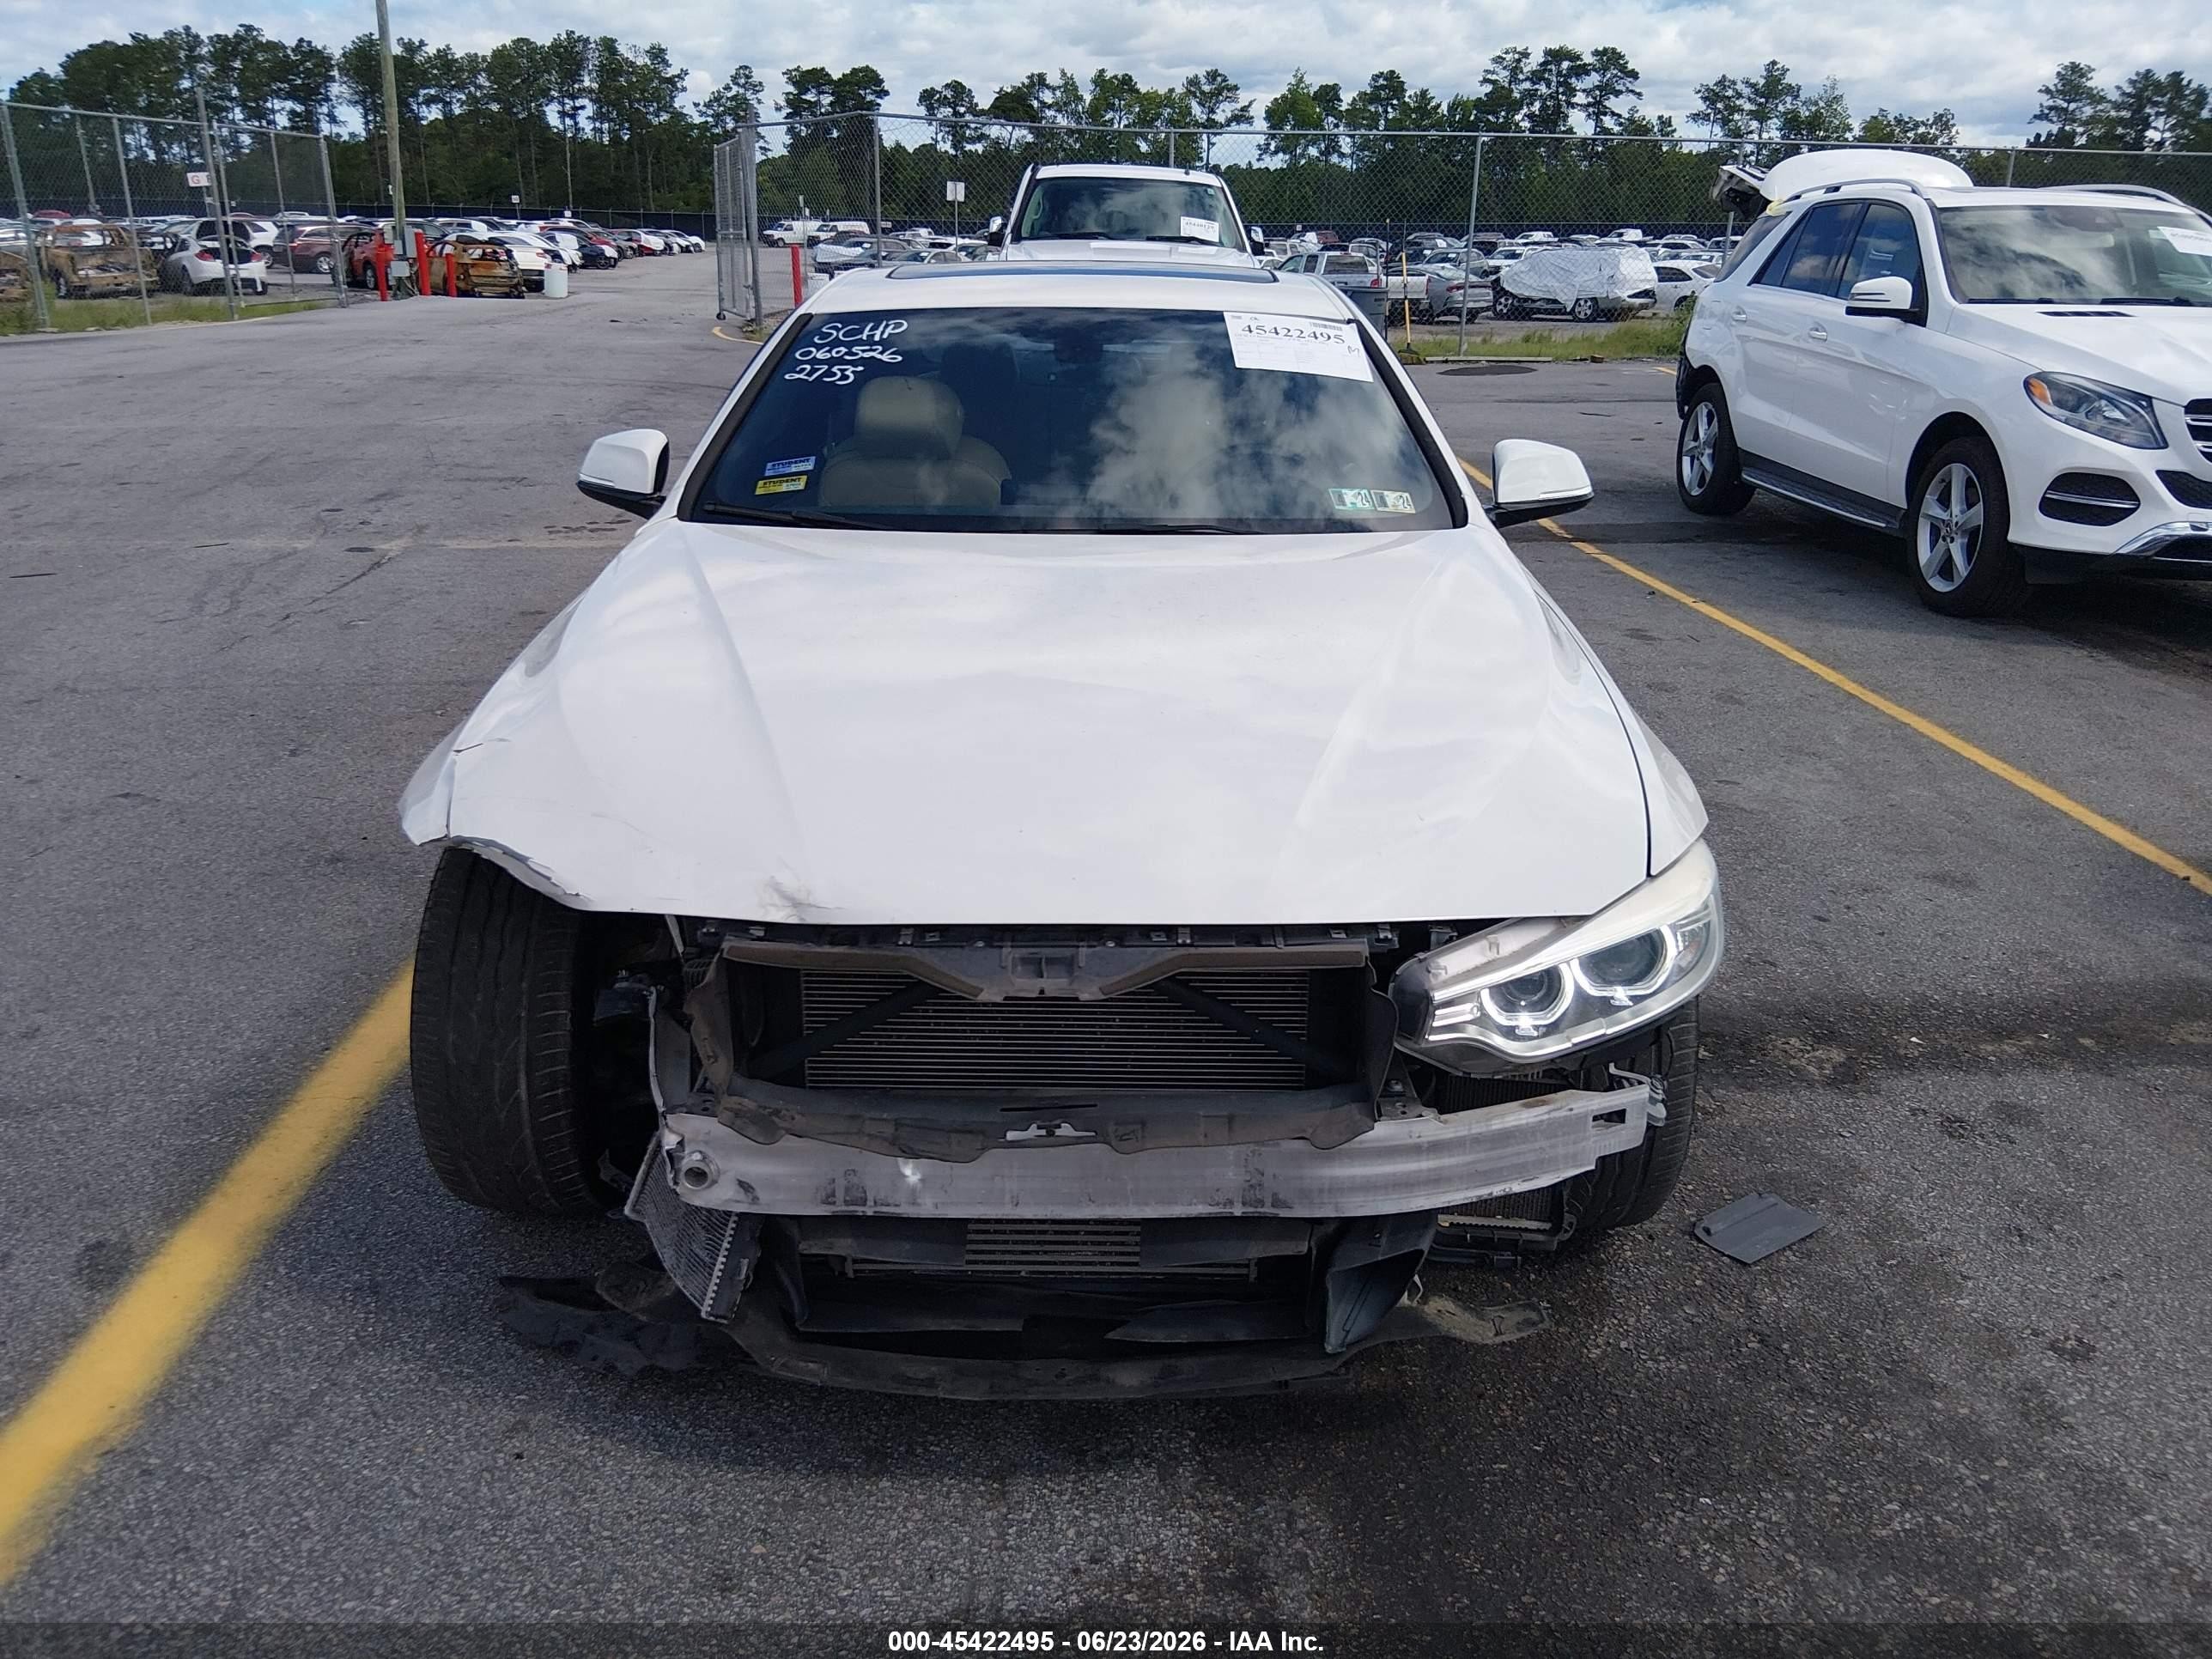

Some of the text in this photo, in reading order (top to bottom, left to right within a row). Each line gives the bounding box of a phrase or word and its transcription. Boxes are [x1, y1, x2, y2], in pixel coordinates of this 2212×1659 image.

[813, 319, 908, 343] SCHP
[1242, 325, 1346, 343] 45422495
[795, 345, 902, 362] 060526
[784, 364, 865, 385] 2755
[771, 458, 811, 467] STUDENT
[763, 477, 802, 486] STUDENT
